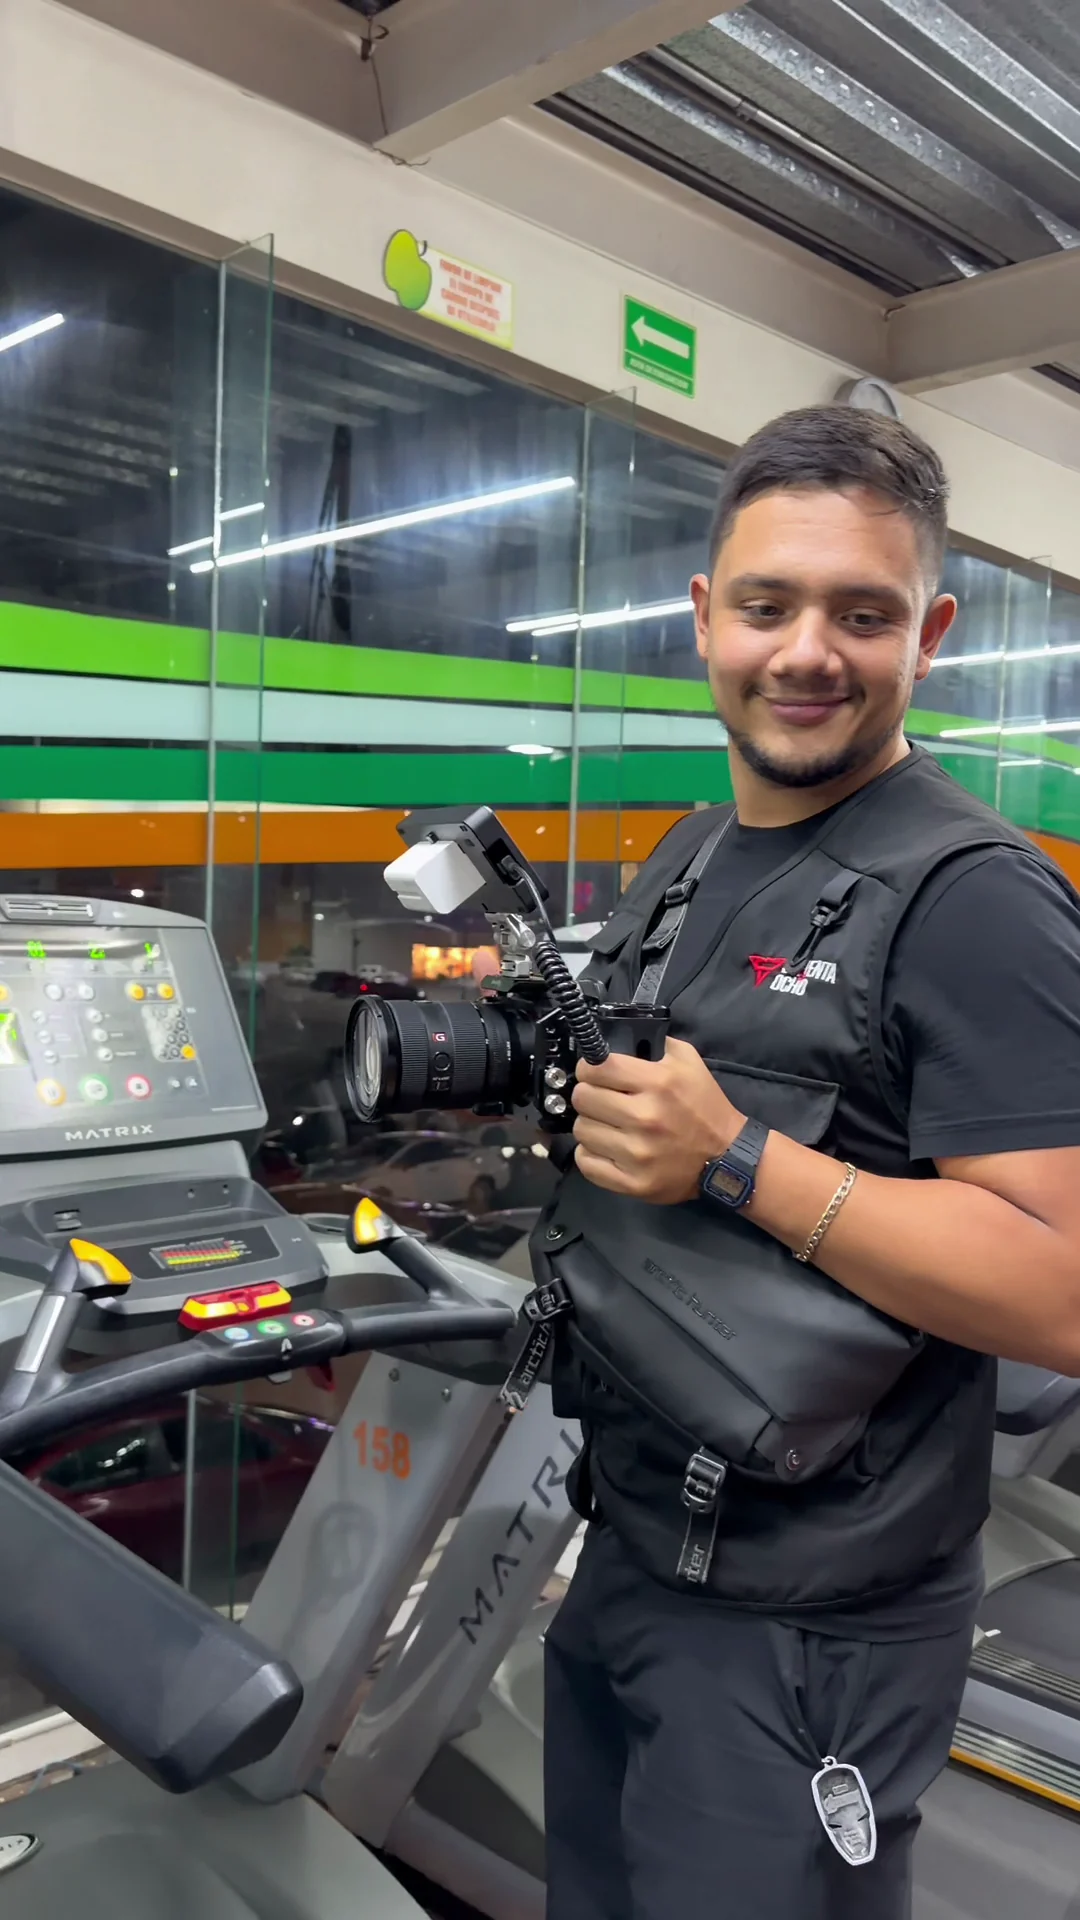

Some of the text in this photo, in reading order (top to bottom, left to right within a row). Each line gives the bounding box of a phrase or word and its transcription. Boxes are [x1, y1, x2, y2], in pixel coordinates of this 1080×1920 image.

[769, 974, 808, 996] OCHO
[64, 1124, 154, 1141] MATRIX
[520, 1333, 552, 1385] arctic
[353, 1419, 412, 1481] 158
[458, 1428, 583, 1645] MATRI
